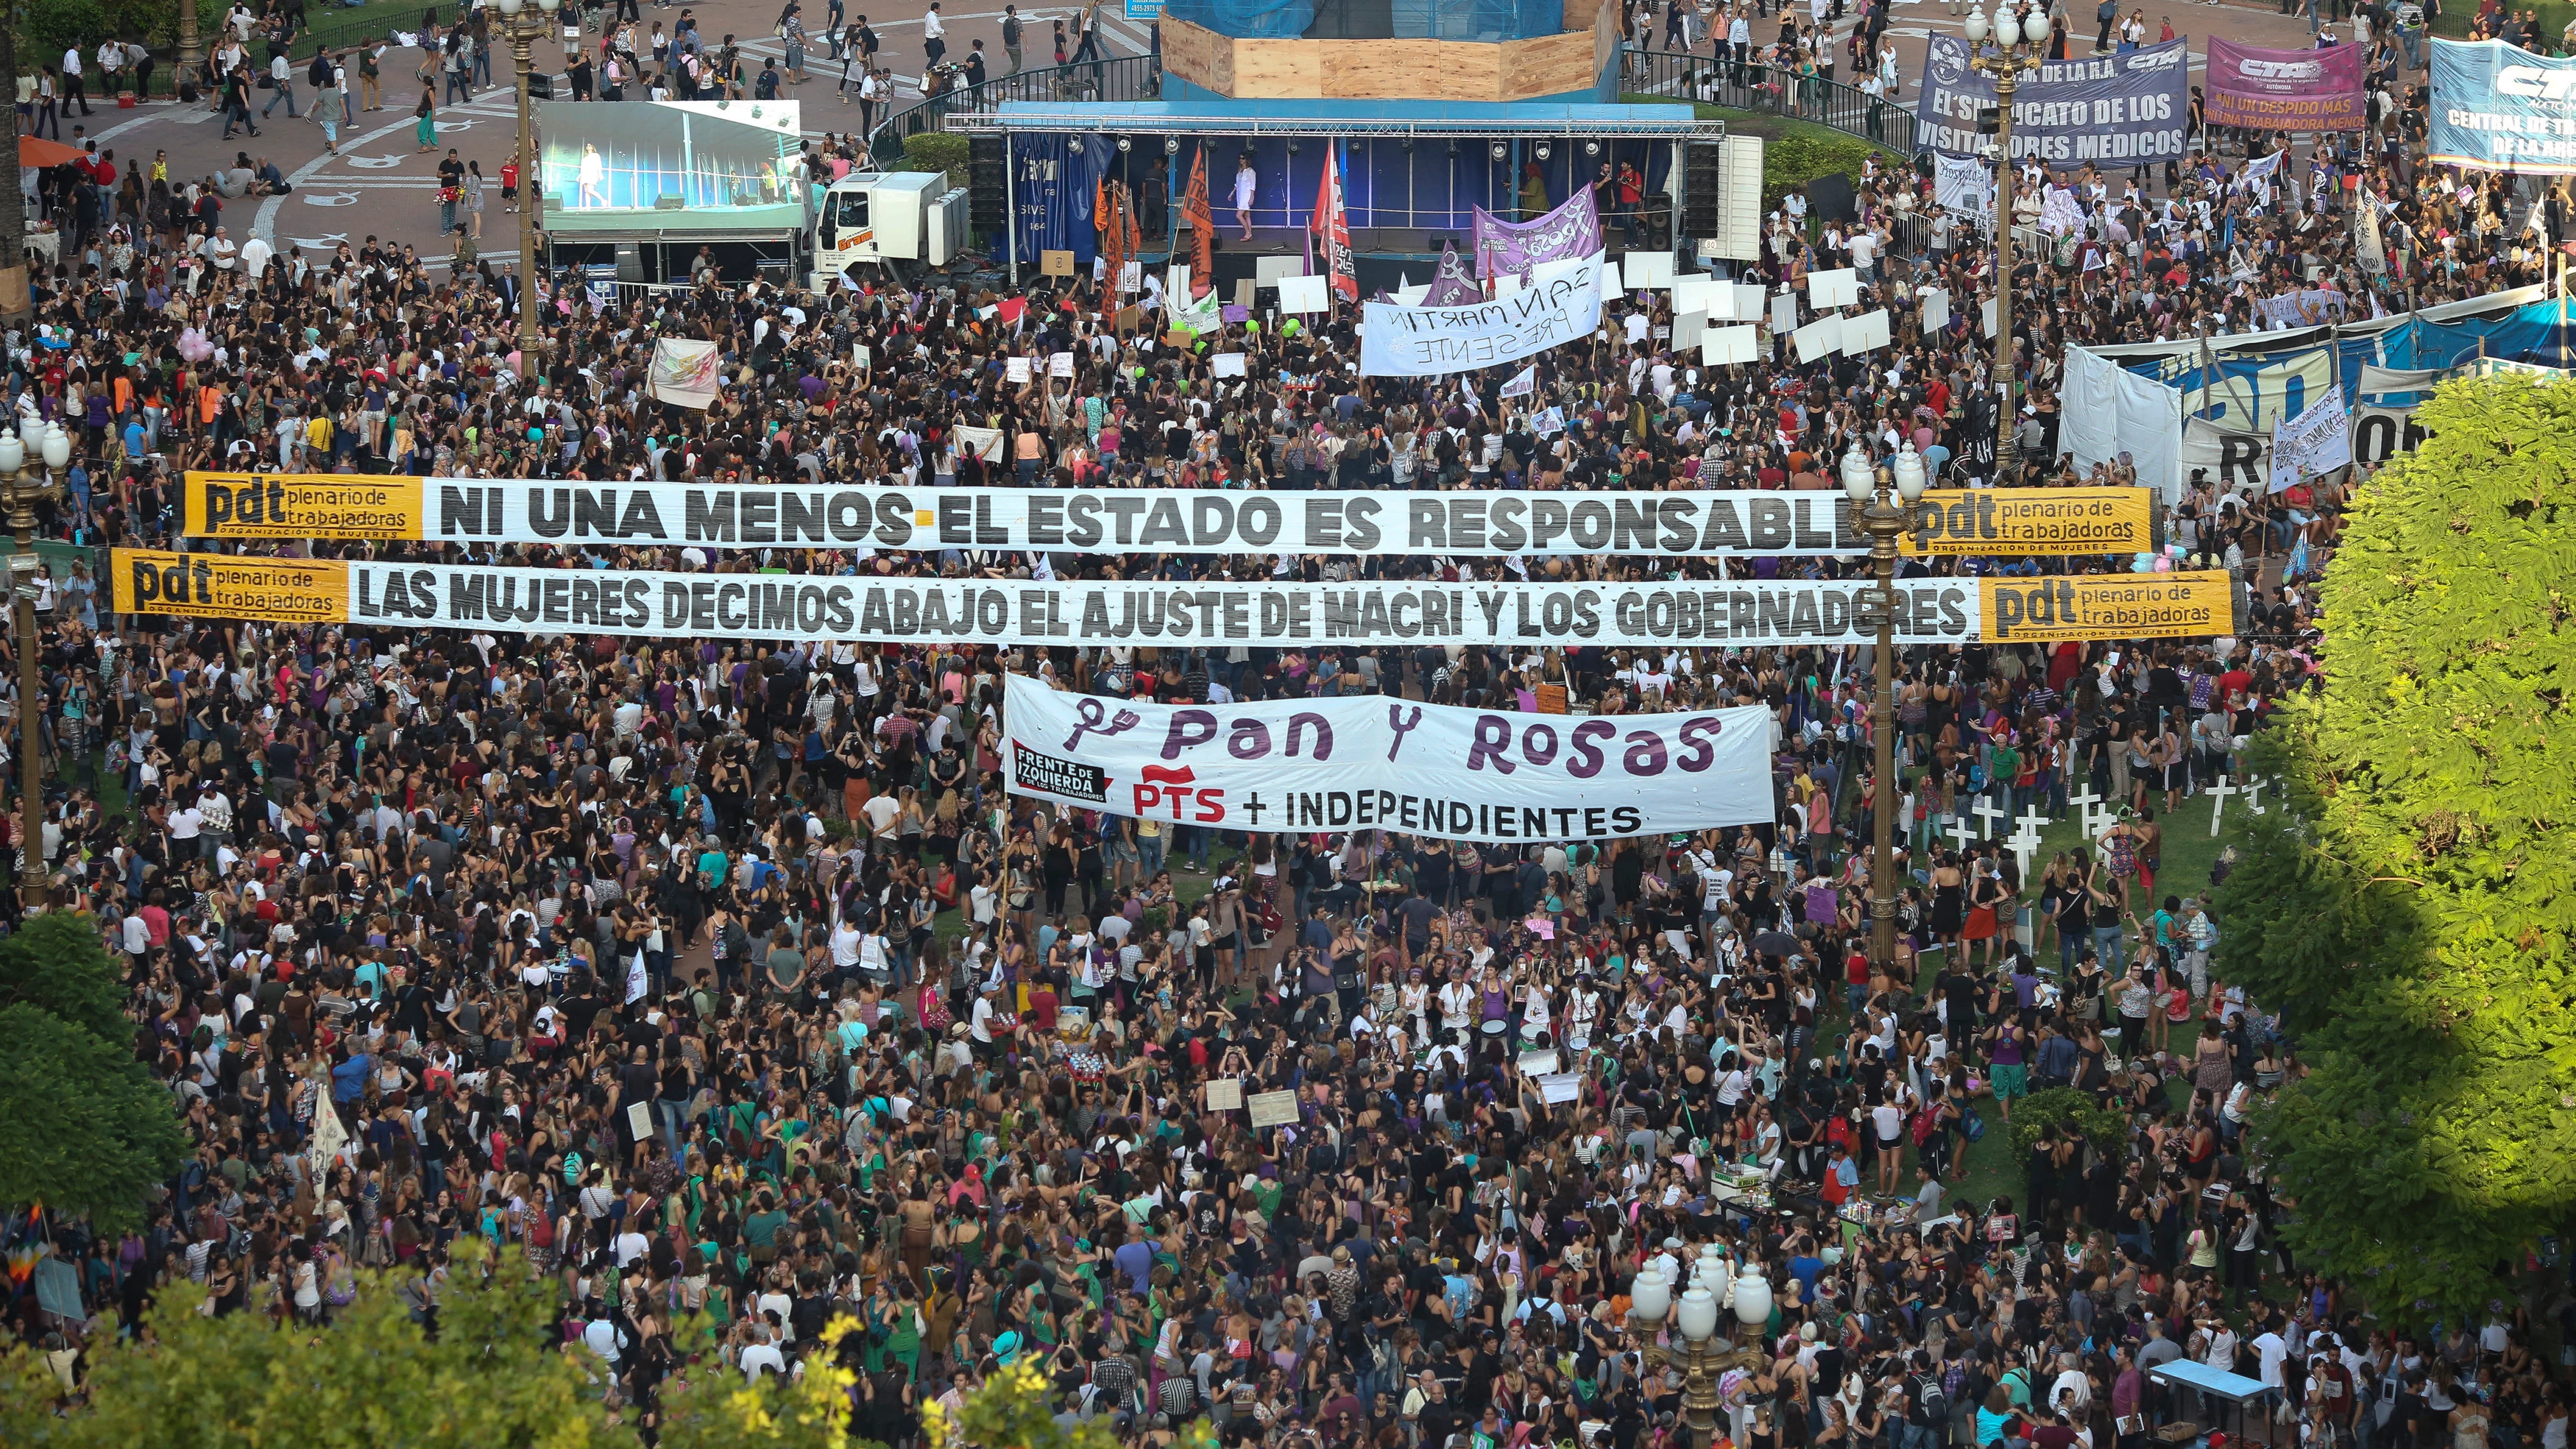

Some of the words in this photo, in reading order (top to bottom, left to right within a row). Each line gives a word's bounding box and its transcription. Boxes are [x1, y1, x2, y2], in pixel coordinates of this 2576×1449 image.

[2042, 64, 2062, 82] DE
[2067, 63, 2087, 82] LA
[2090, 59, 2119, 79] R.A.
[2239, 58, 2308, 78] CTA
[1933, 87, 1953, 116] EL
[2094, 99, 2124, 124] DE
[2129, 93, 2172, 123] LOS
[2215, 93, 2235, 109] #NI
[2237, 97, 2257, 111] UN
[2258, 100, 2319, 115] DESPIDO
[2321, 96, 2352, 115] MÁS
[2220, 110, 2241, 126] UNA
[2243, 115, 2325, 131] TRABAJADORA
[2327, 115, 2366, 131] MENOS
[2447, 110, 2524, 132] CENTRAL
[2527, 116, 2550, 134] DE
[2076, 129, 2183, 159] MEDICOS
[2493, 137, 2514, 155] DE
[2522, 138, 2539, 156] LA
[205, 477, 286, 534] pdt
[288, 486, 363, 510] plenario
[365, 488, 387, 506] de
[287, 509, 406, 528] trabajadoras
[441, 486, 504, 536] NI
[528, 487, 668, 539] UNA
[684, 490, 914, 548] MENOS
[938, 494, 1009, 545] EL
[1027, 495, 1282, 548] ESTADO
[1305, 496, 1382, 550] ES
[1915, 492, 1998, 551] pdt
[2001, 500, 2088, 519] plenario
[2090, 500, 2114, 517] de
[220, 526, 311, 536] ORGANIZACION
[315, 529, 330, 537] DE
[336, 530, 397, 539] MUJERES
[2002, 520, 2134, 540] trabajadoras
[1933, 545, 2028, 553] ORGANIZACION
[2050, 543, 2109, 552] MUJERES
[132, 555, 213, 611] pdt
[216, 570, 289, 589] plenario
[291, 572, 313, 588] de
[216, 589, 333, 611] trabajadoras
[358, 568, 438, 620] LAS
[449, 573, 651, 629] MUJERES
[662, 581, 855, 634] DECIMOS
[860, 587, 1008, 638] ABAJO
[1019, 589, 1070, 637] EL
[1080, 589, 1250, 639] AJUSTE
[1260, 591, 1312, 638] DE
[1324, 589, 1462, 639] MACRI
[1474, 590, 1509, 637] Y
[1517, 589, 1603, 639] LOS
[1995, 578, 2077, 638] pdt
[2081, 587, 2162, 606] plenario
[2168, 585, 2192, 602] de
[149, 606, 238, 617] ORGANIZACION
[265, 612, 322, 622] MUJERES
[2082, 605, 2211, 625] trabajadoras
[2014, 630, 2108, 640] ORGANIZACION
[2131, 628, 2190, 637] MUJERES
[1160, 709, 1334, 762] Pan
[1017, 748, 1077, 776] FRENTE
[1079, 768, 1093, 779] DE
[1017, 762, 1094, 793] IZQUIERDA
[1036, 781, 1048, 790] LOS
[1050, 784, 1104, 801] TRABAJADORES
[1133, 783, 1225, 823] PTS
[1287, 788, 1642, 837] INDEPENDIENTES
